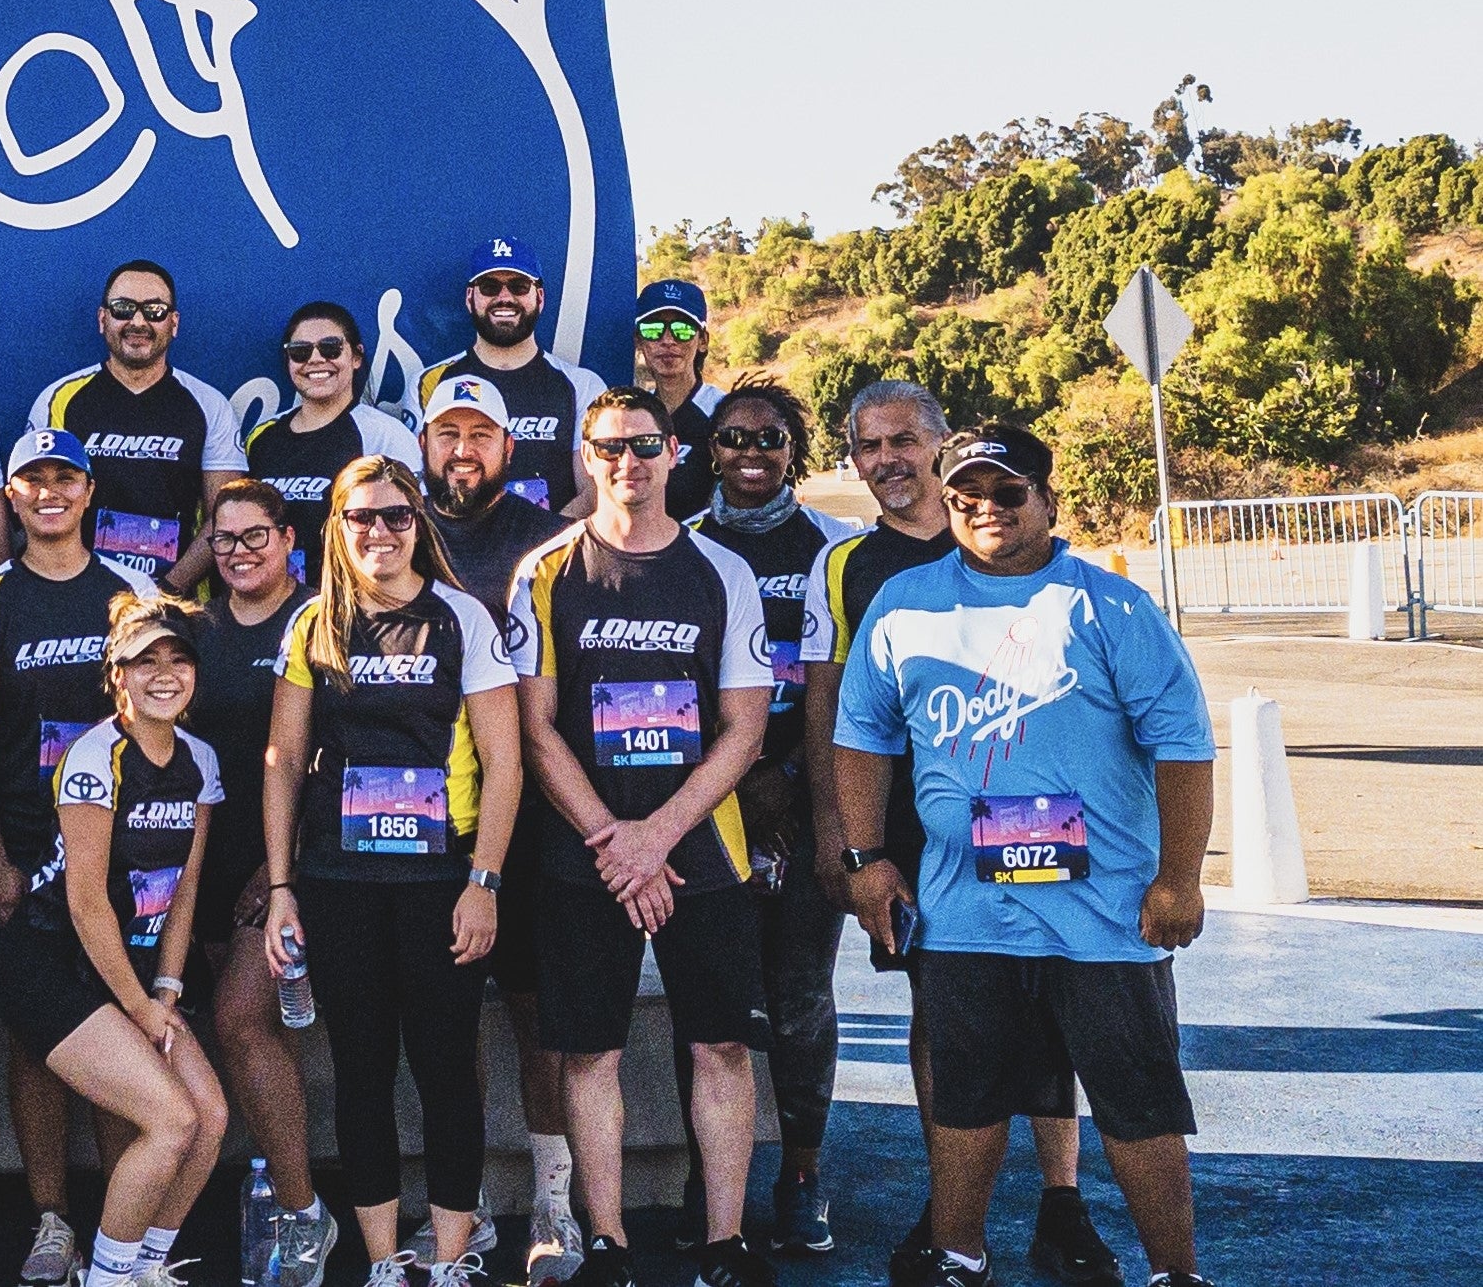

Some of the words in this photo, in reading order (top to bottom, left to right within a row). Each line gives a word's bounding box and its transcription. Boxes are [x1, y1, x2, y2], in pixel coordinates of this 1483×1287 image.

[492, 239, 512, 257] LA
[507, 416, 559, 432] NGO
[36, 432, 55, 453] B
[84, 432, 183, 453] LONGO
[513, 432, 556, 440] EXUS
[84, 448, 123, 457] TOYOTA
[124, 449, 179, 460] LEXUS
[261, 477, 331, 492] ONGO
[283, 492, 323, 501] EXUS
[579, 618, 700, 642] LONGO
[579, 638, 628, 649] TOYOTA
[628, 640, 695, 653] LEXUS
[16, 655, 60, 671] TOYOTA
[350, 654, 437, 674] ONGO
[622, 729, 669, 751] 1401
[613, 754, 631, 766] 5K
[127, 819, 168, 829] TOYOTA
[368, 816, 418, 838] 1856
[357, 840, 374, 852] 5K
[1002, 845, 1058, 868] 6072
[994, 871, 1012, 883] 5K
[130, 935, 144, 945] 5K
